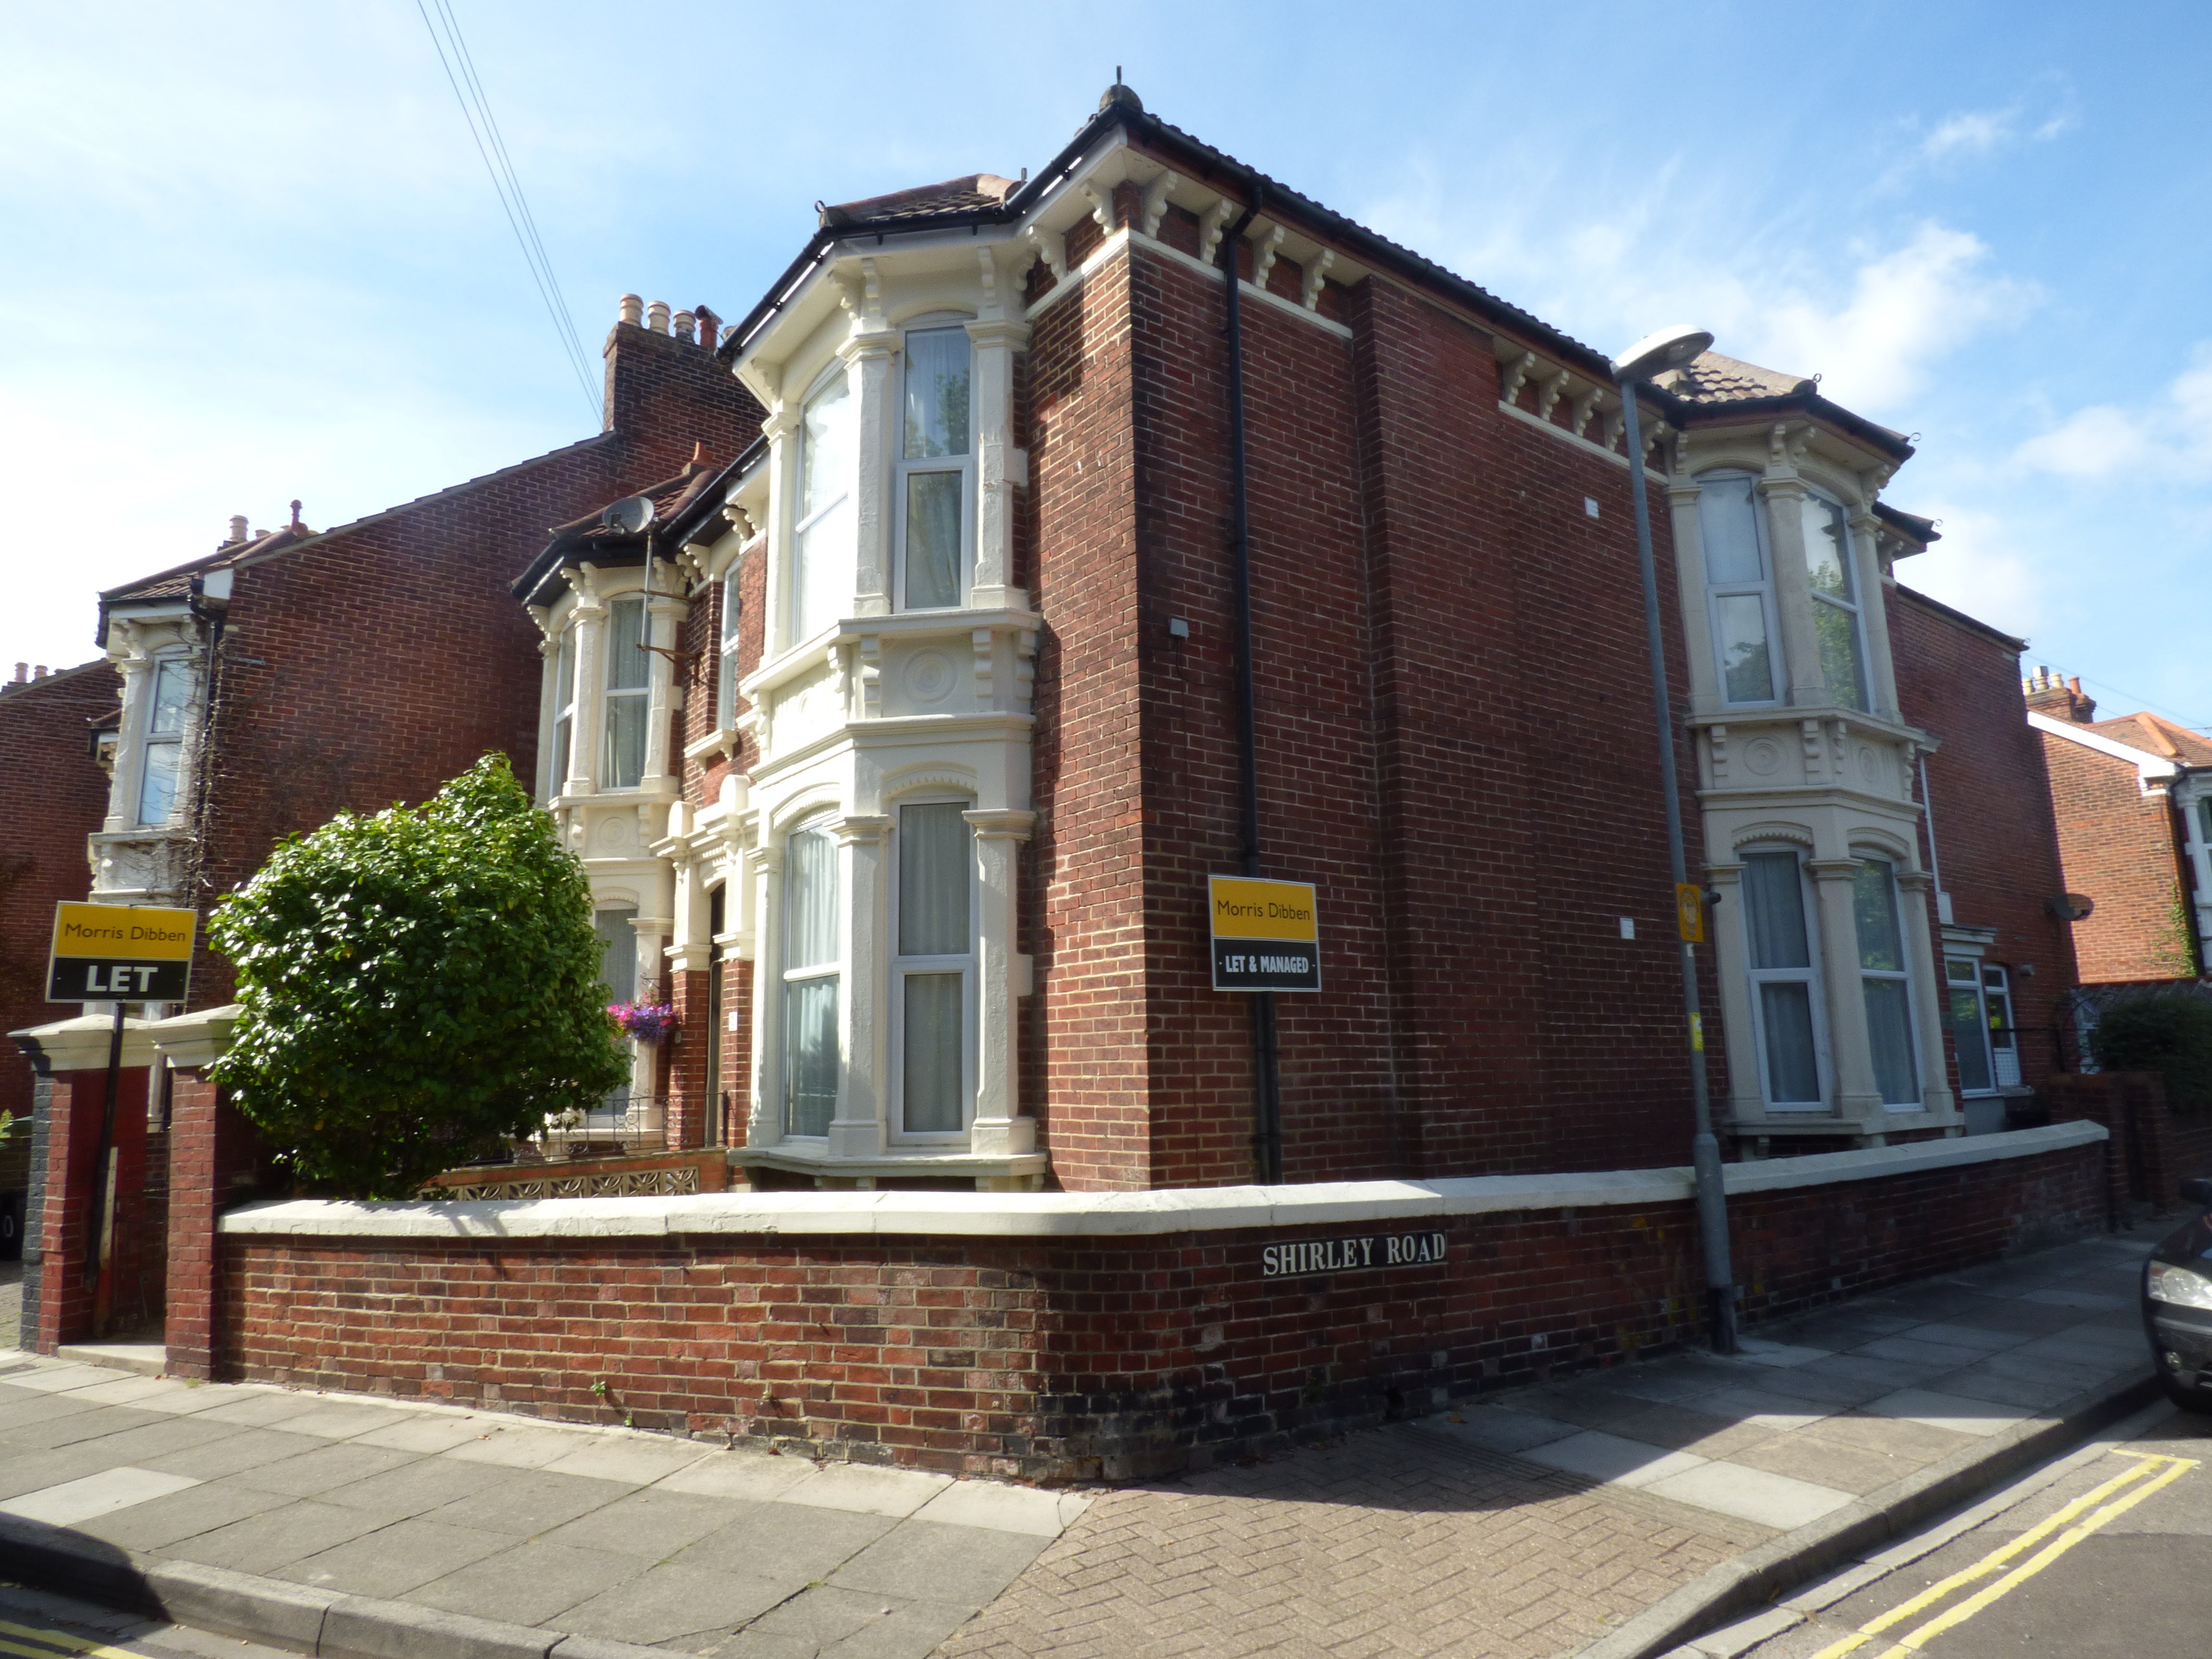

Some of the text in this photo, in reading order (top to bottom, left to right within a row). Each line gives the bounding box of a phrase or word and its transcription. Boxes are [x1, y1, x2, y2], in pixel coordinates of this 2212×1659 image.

[1218, 900, 1310, 920] Morris Dibben
[65, 923, 185, 942] Morris Dibben
[1225, 955, 1309, 973] LET & MANAGED
[86, 965, 158, 992] LET
[1263, 1233, 1445, 1276] SHIRLEY ROAD
